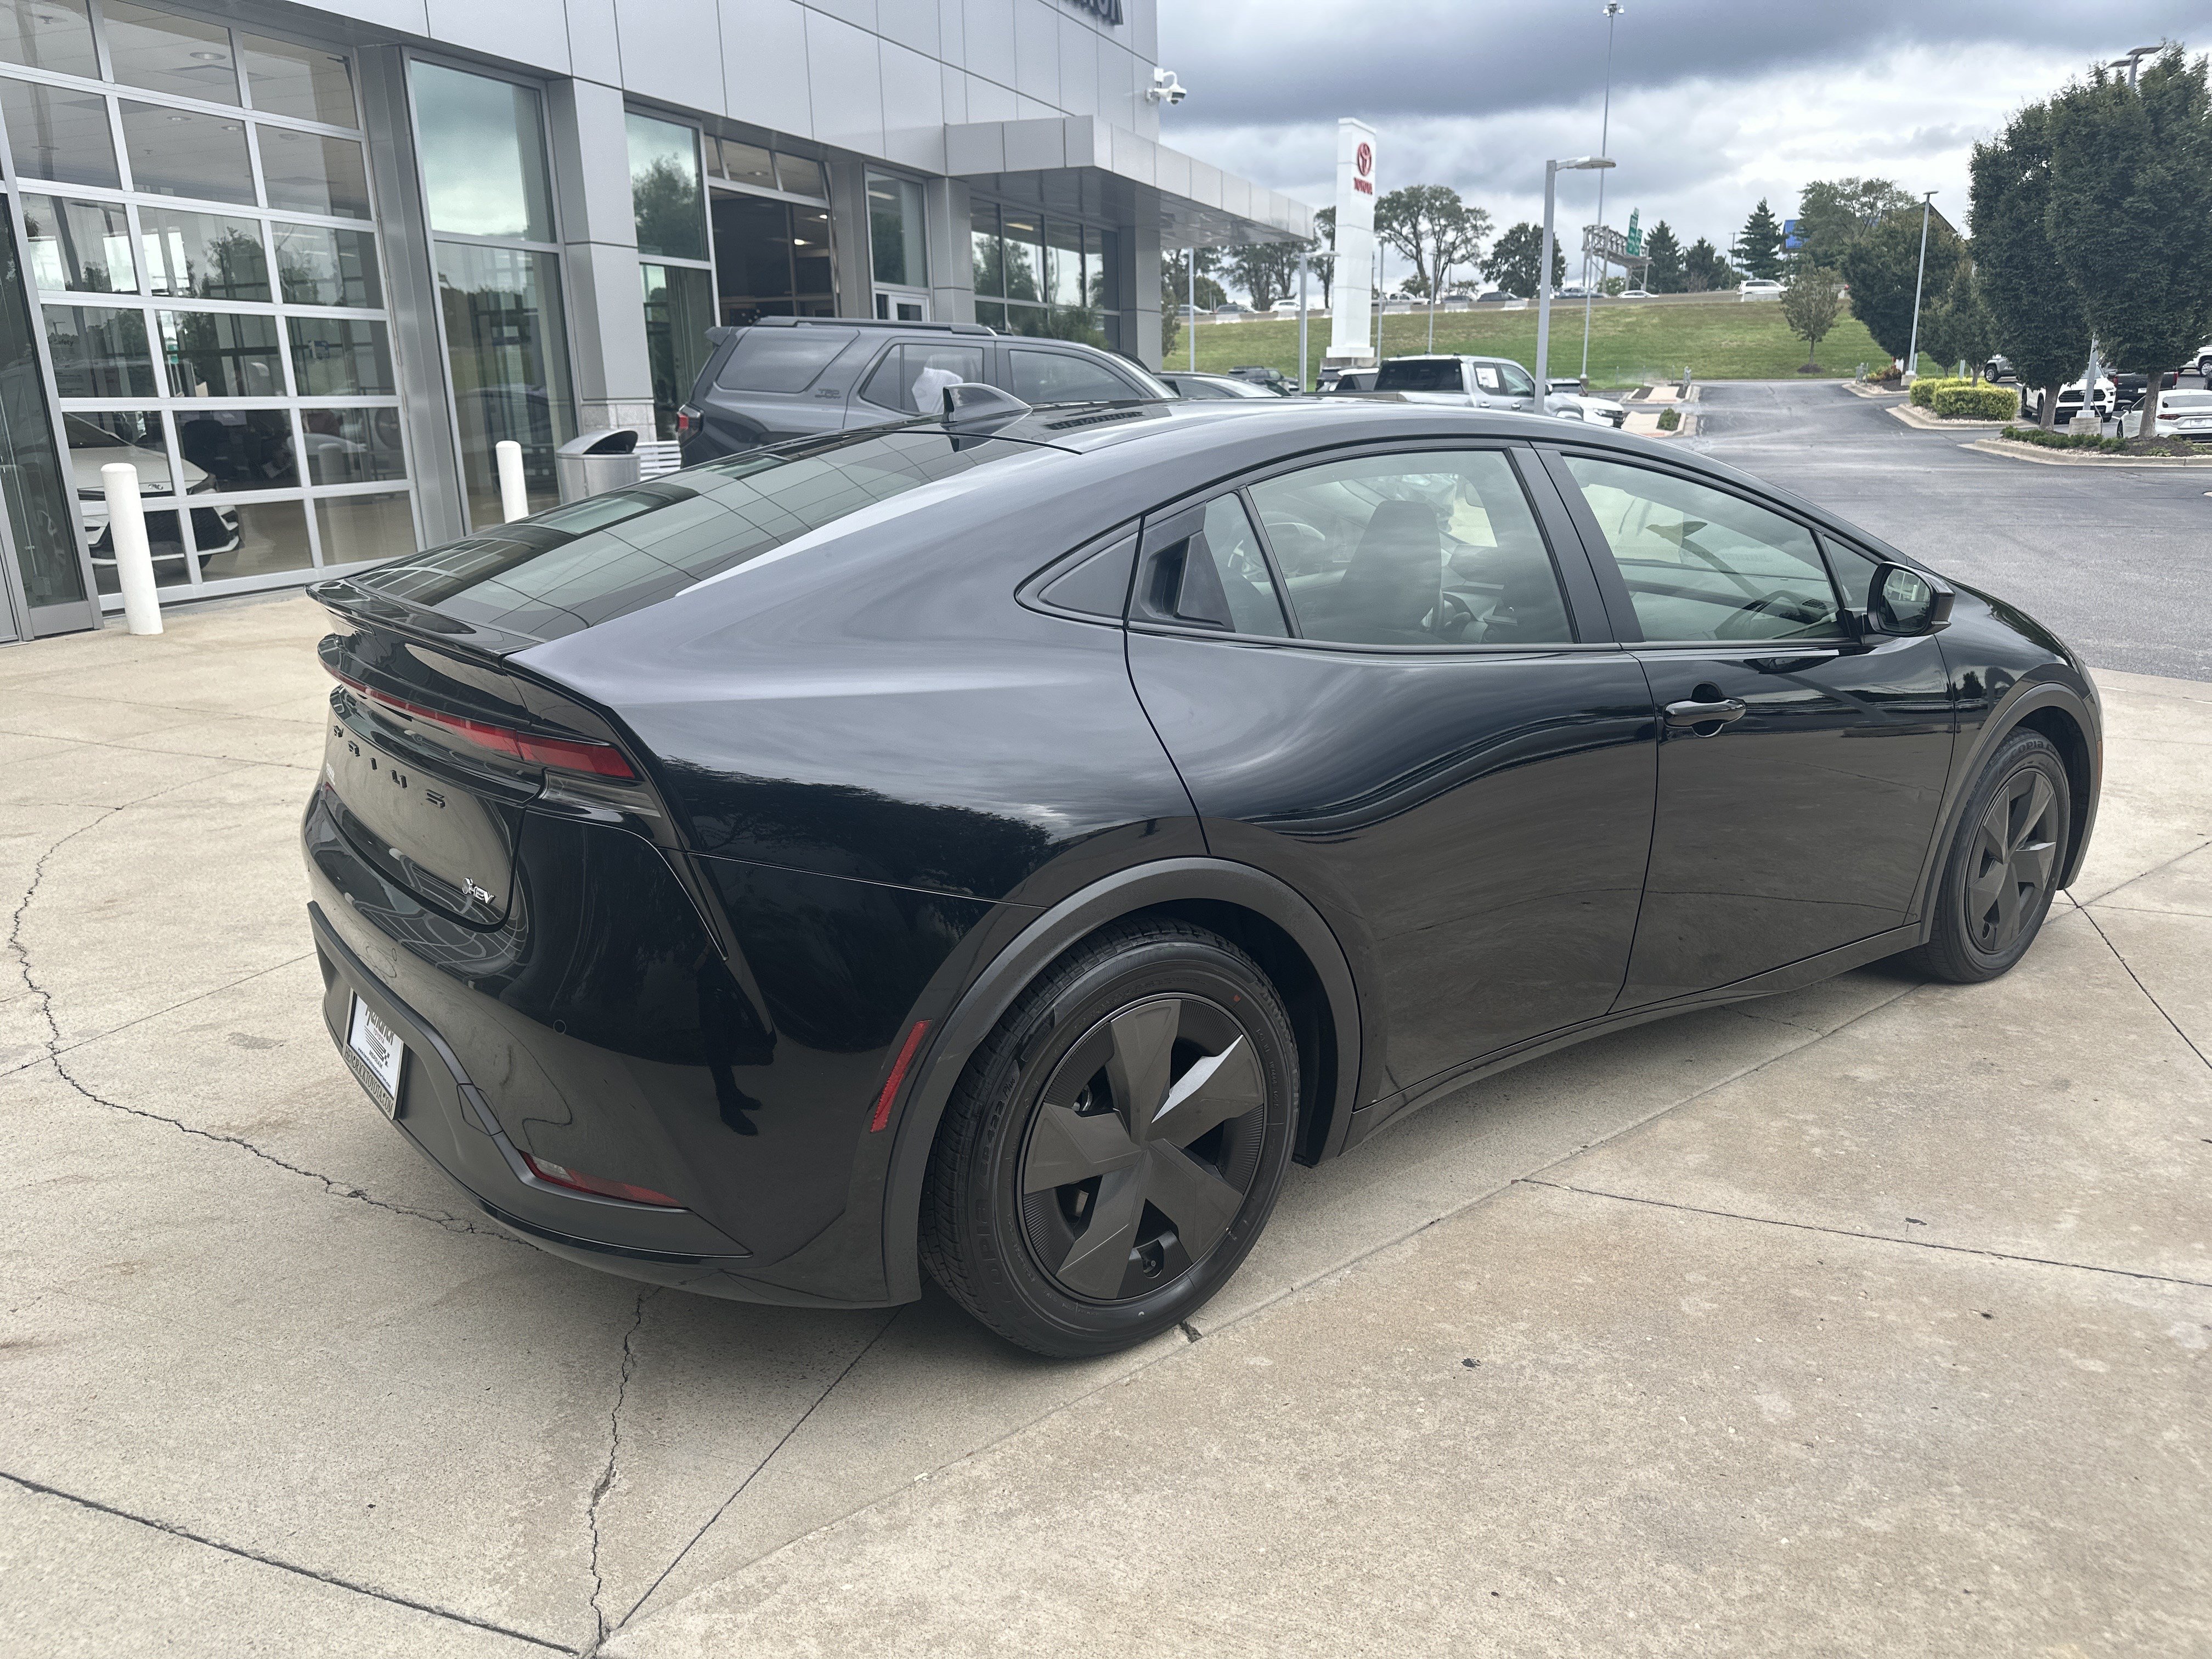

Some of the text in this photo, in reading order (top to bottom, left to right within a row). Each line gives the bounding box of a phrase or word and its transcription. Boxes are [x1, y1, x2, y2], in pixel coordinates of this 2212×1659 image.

[333, 725, 445, 809] PRIUS
[469, 883, 496, 904] HEV
[373, 1027, 385, 1045] TOYOTA
[344, 1045, 393, 1116] HENDRICKTOYOTA.COM
[1002, 1077, 1016, 1098] Plus
